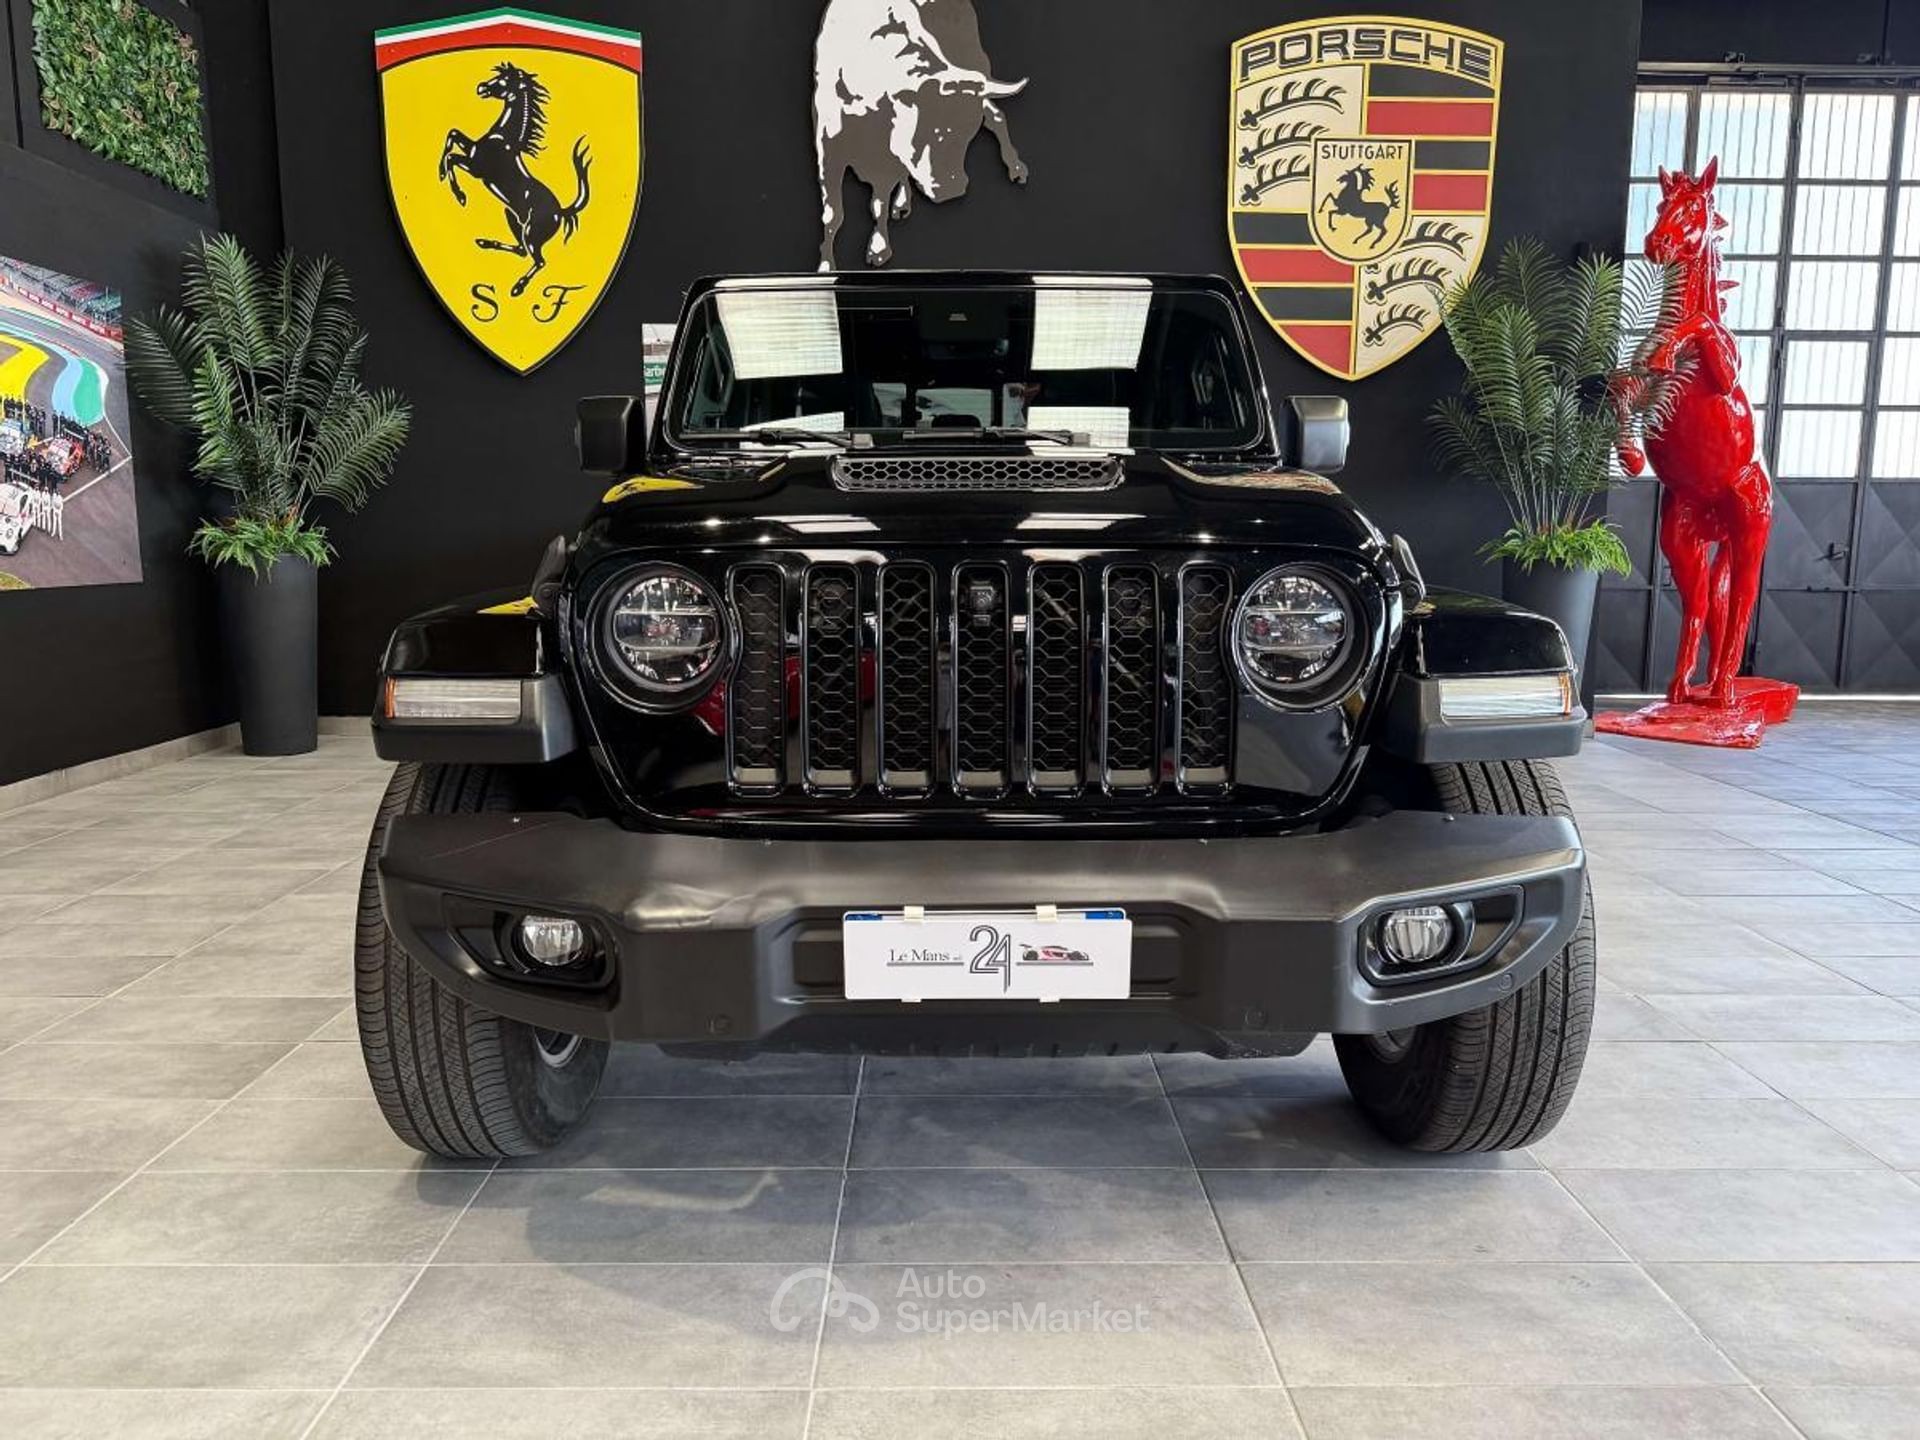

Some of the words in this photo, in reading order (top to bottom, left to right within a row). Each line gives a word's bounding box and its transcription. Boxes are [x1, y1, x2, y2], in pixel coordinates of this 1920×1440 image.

[1239, 28, 1493, 83] PORSCHE
[1320, 144, 1404, 161] STUTTGART
[470, 283, 499, 322] S
[531, 284, 588, 323] F
[889, 948, 908, 961] Le
[911, 948, 950, 961] Mans
[969, 924, 1011, 994] 24
